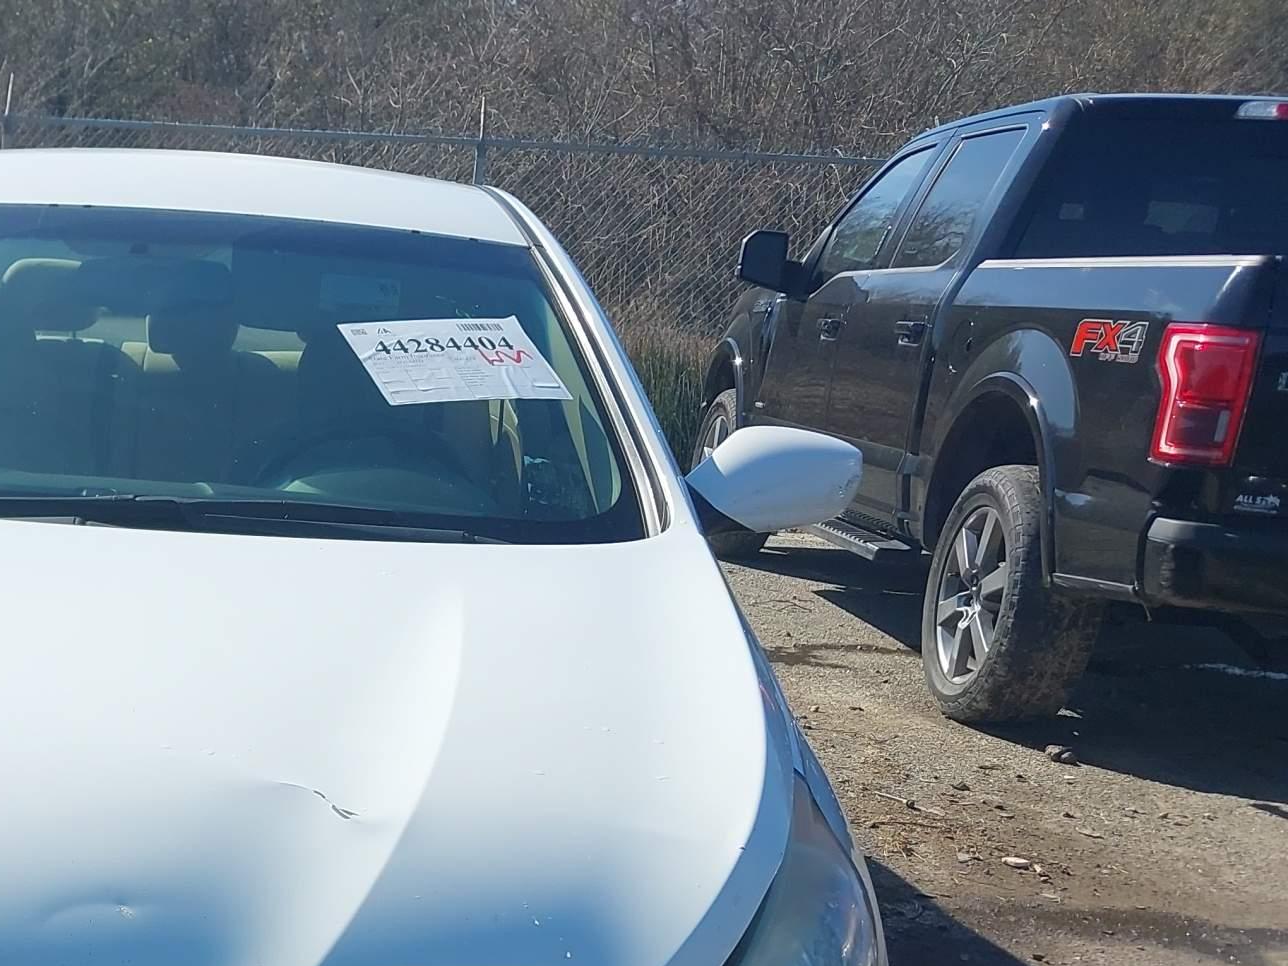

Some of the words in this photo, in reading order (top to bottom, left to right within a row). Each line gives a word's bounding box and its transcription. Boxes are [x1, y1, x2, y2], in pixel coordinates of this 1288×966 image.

[375, 335, 514, 355] 44284404
[1070, 318, 1149, 357] FX4
[1235, 494, 1253, 504] ALL
